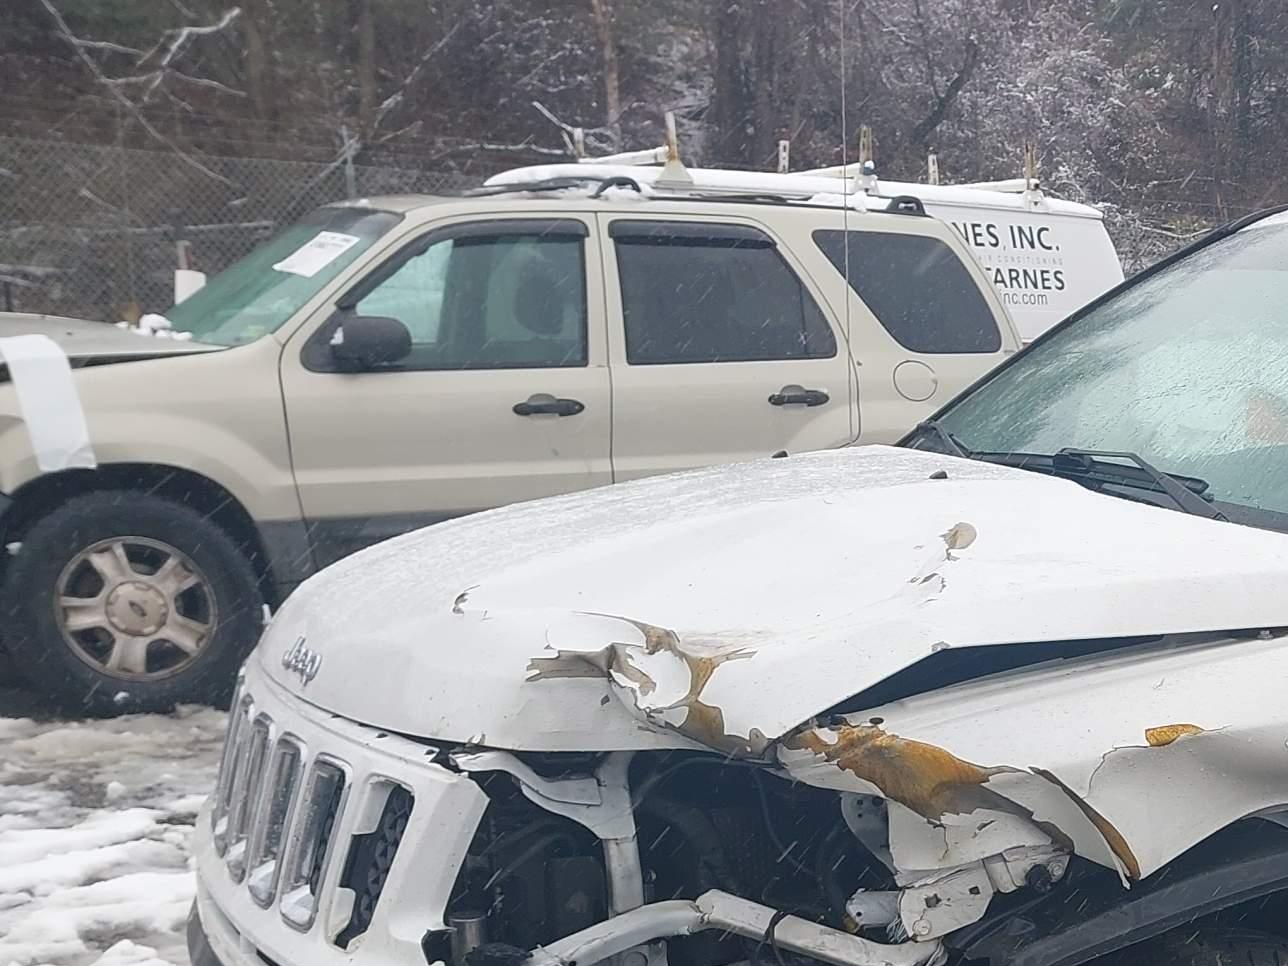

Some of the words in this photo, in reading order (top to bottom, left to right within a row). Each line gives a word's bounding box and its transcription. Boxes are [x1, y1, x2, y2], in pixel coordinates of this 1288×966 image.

[1009, 225, 1060, 251] INC.
[985, 267, 1065, 291] ARNES
[281, 636, 322, 687] Jeep
